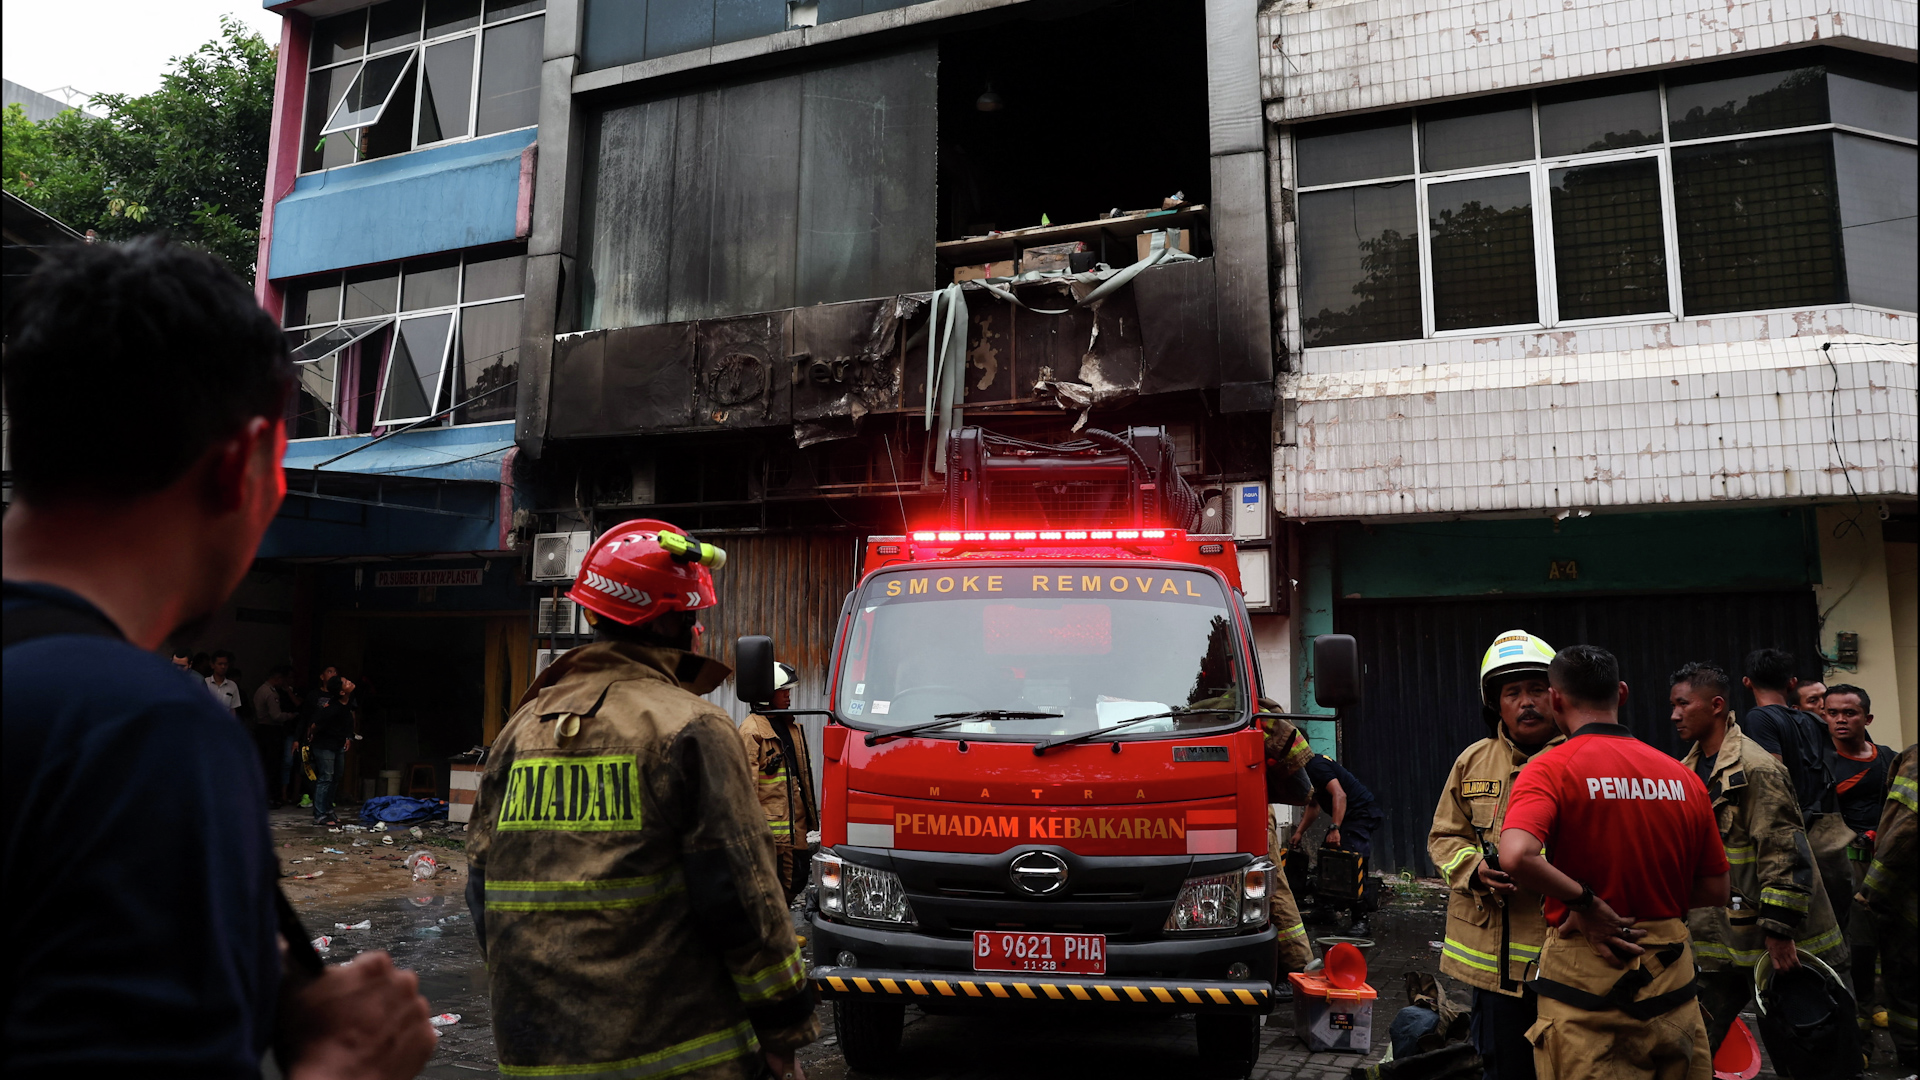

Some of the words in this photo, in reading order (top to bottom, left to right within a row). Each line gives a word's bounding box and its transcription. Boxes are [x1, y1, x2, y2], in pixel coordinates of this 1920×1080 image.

[1549, 560, 1578, 580] A-4
[886, 575, 1003, 597] SMOKE
[1032, 575, 1202, 597] REMOVAL
[851, 702, 863, 710] OK
[501, 762, 634, 822] EMADAM
[1586, 777, 1686, 801] PEMADAM
[895, 813, 1019, 838] PEMADAM
[1029, 816, 1185, 839] KEBAKARAN
[978, 934, 991, 957] B
[1002, 935, 1052, 959] 9621
[1064, 937, 1102, 961] PHA
